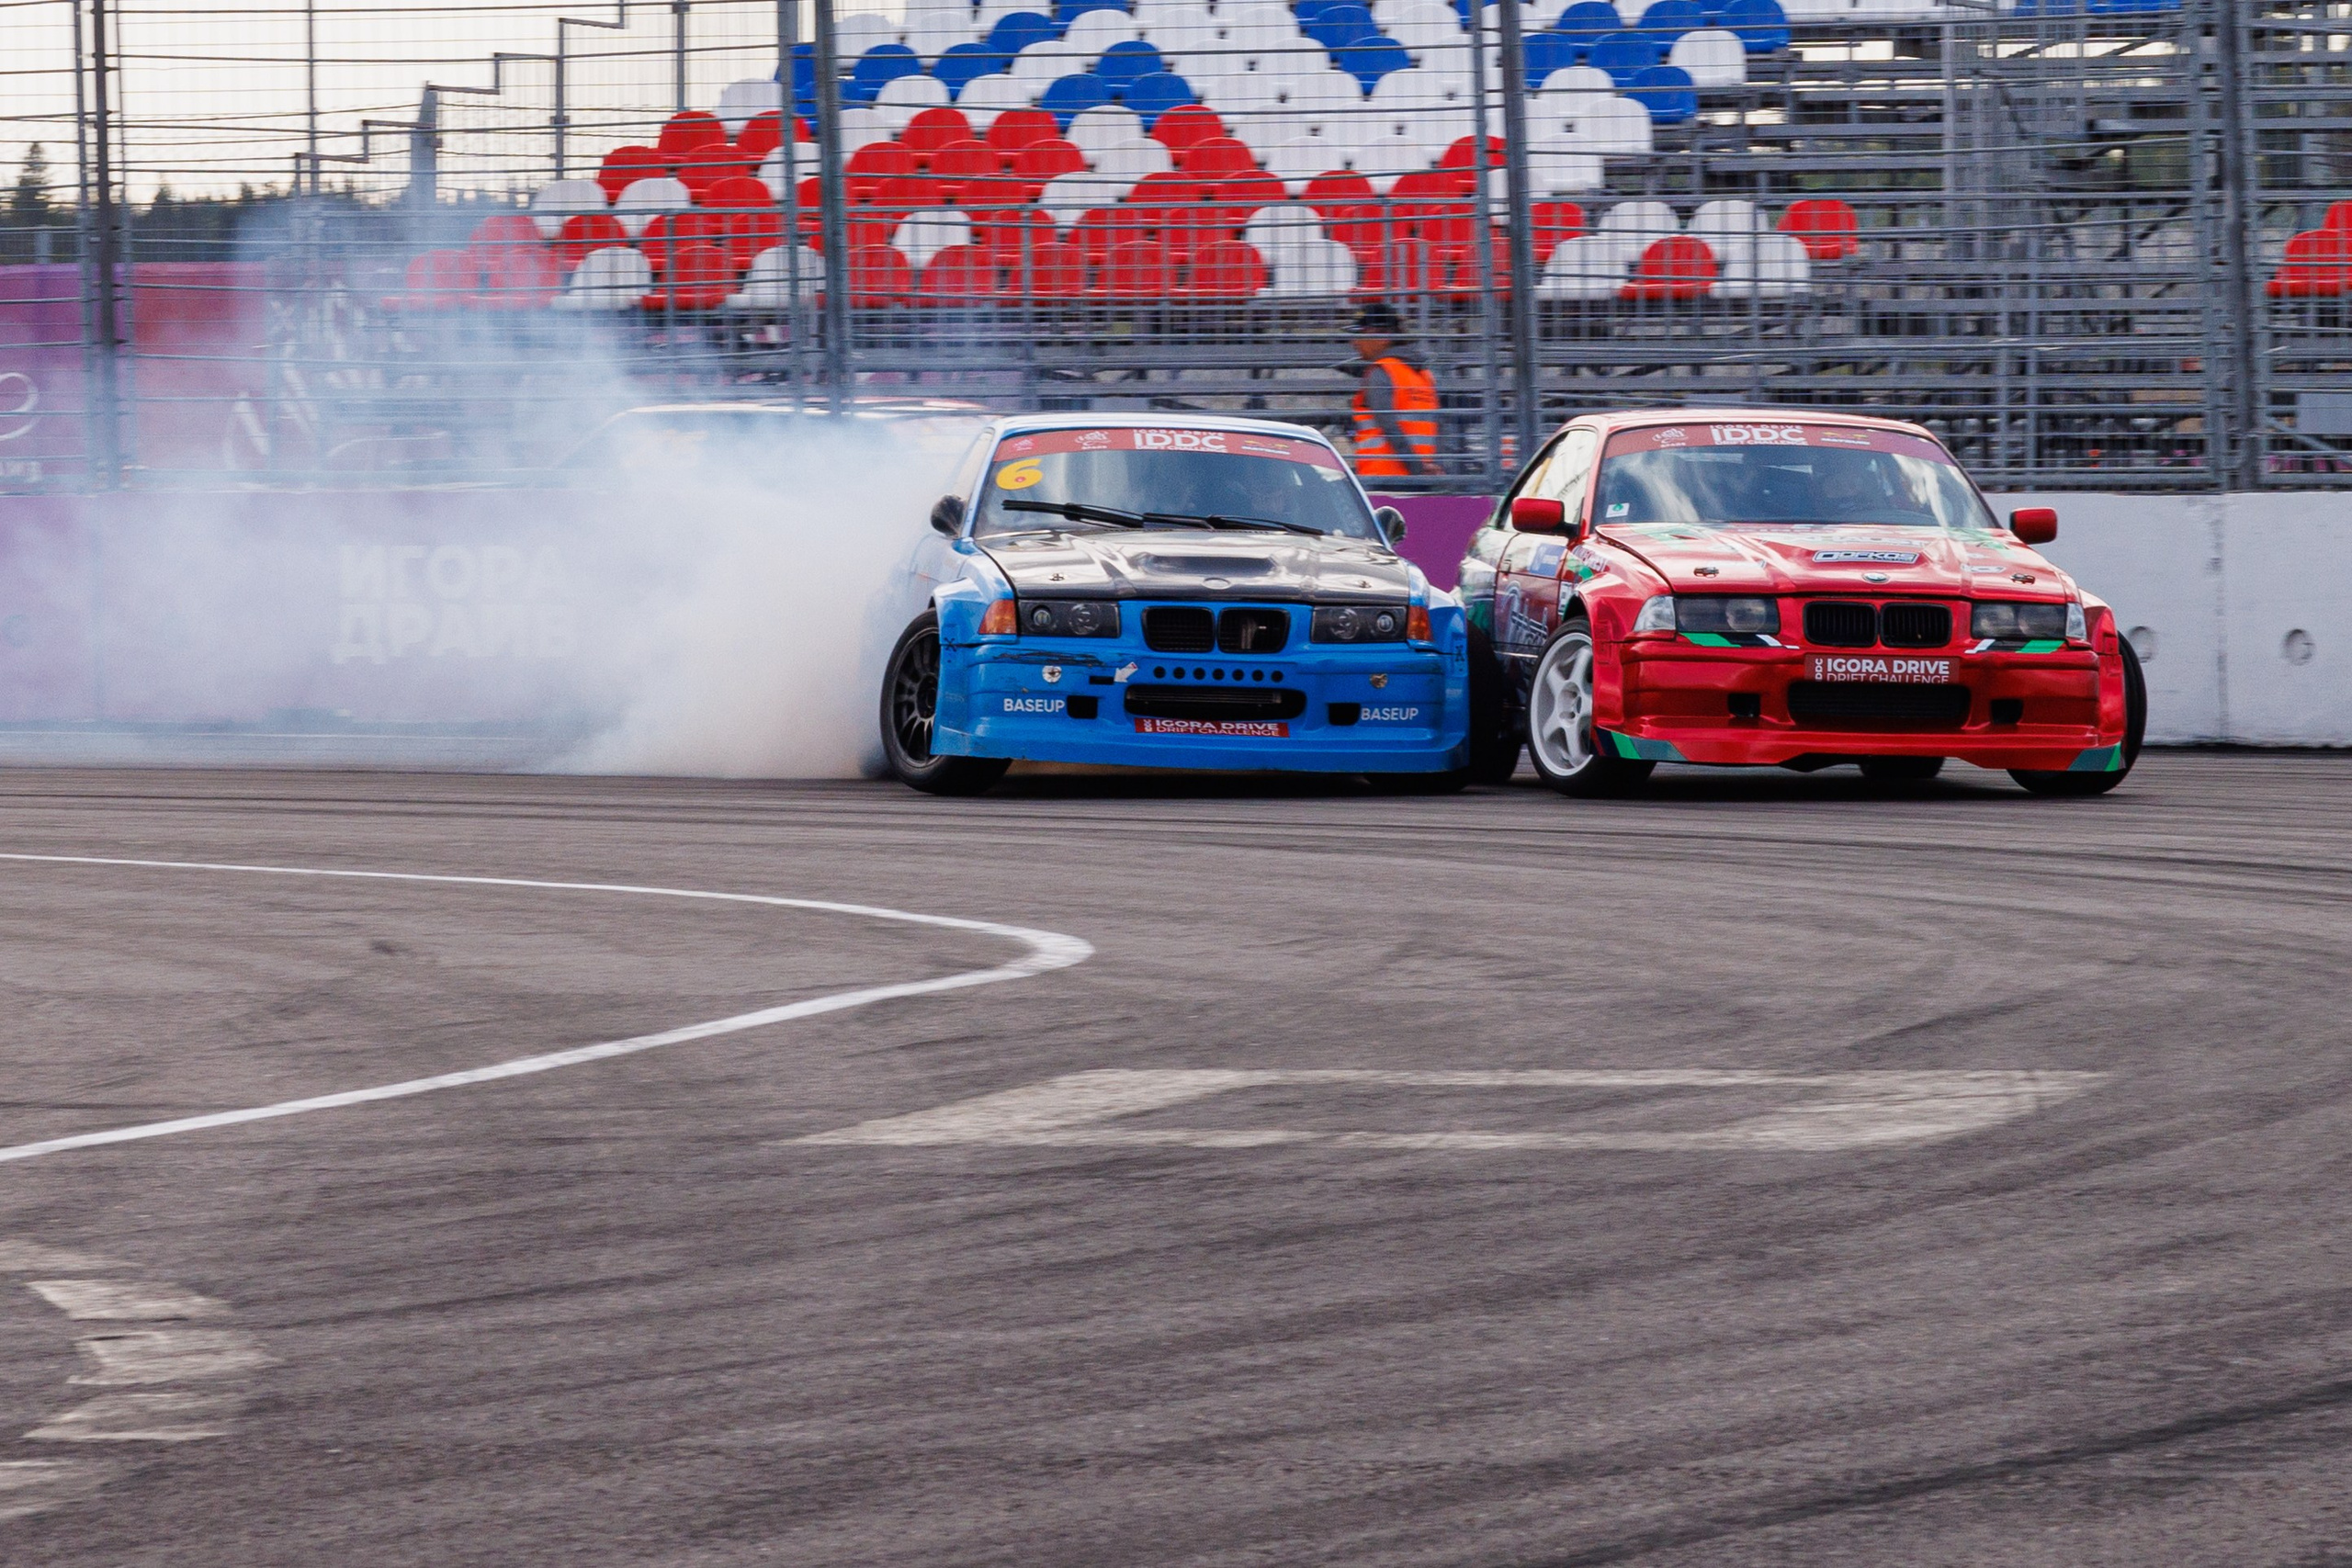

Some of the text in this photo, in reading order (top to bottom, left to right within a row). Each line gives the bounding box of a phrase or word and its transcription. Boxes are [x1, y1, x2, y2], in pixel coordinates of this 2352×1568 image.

[1134, 433, 1227, 449] IDDC
[1712, 428, 1806, 442] IDDC
[995, 458, 1043, 491] 6
[339, 544, 571, 600] ИГОРА
[1826, 658, 1951, 675] IGORA DRIVE
[1826, 672, 1950, 684] DRIFT CHALLENGE
[1003, 698, 1066, 713] BASEUP
[1361, 707, 1419, 721] BASEUP
[1155, 719, 1279, 731] IGORA DRIVE
[1156, 726, 1280, 737] DRIFT CHALLENGE
